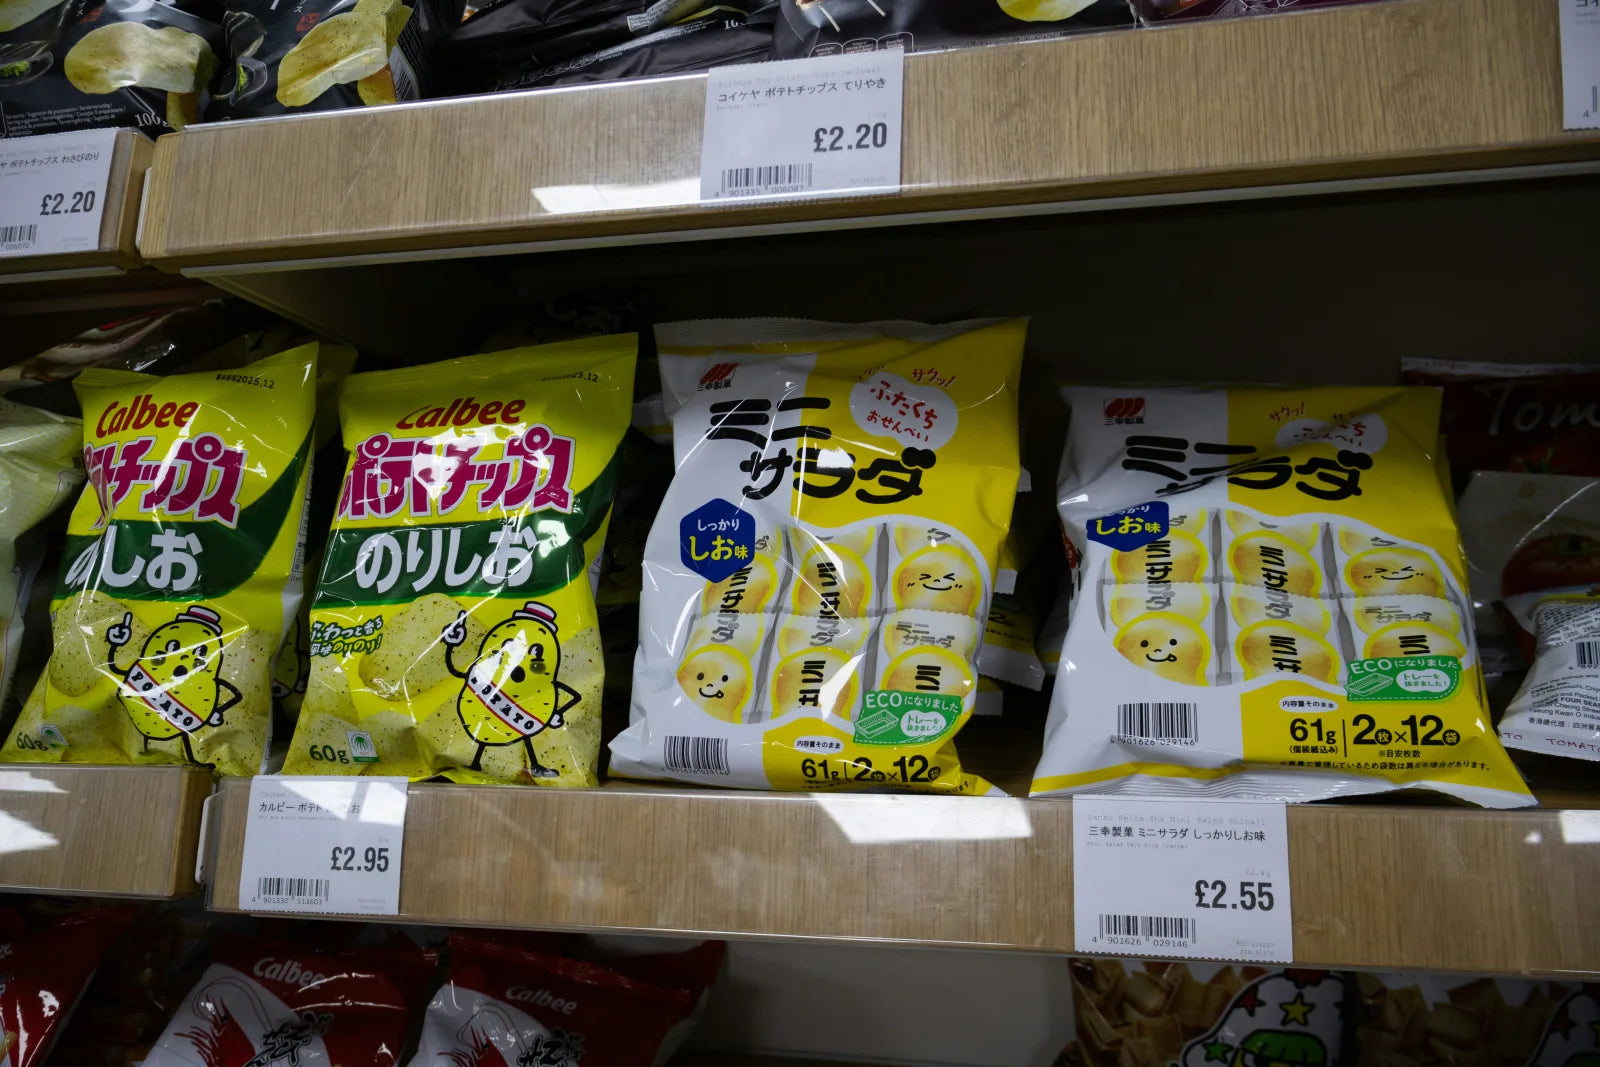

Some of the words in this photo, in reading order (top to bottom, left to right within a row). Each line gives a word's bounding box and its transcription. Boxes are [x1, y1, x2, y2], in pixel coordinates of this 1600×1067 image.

[718, 90, 760, 102] コイケヤ
[765, 82, 837, 97] ポテトチップス
[843, 78, 886, 91] てりやき
[813, 122, 888, 152] £2.20
[9, 155, 58, 168] ポテトチップス
[62, 151, 100, 163] わさびのり
[40, 190, 96, 216] £2.20
[728, 187, 761, 197] 901335
[771, 185, 805, 194] 006087
[96, 394, 200, 439] Calbee
[396, 398, 526, 430] Calbee
[870, 380, 938, 430] ふたくち
[705, 397, 832, 450] ミニ
[867, 409, 930, 442] おせんべい
[1122, 435, 1257, 482] ミニ
[336, 423, 577, 521] ポテトチップス
[739, 446, 937, 504] サラダ
[697, 518, 740, 532] しっかり
[1096, 515, 1162, 535] しお味
[355, 525, 538, 594] のりしお
[689, 534, 749, 562] しお味
[1350, 659, 1461, 675] ECOになりました
[1403, 673, 1441, 681] トレーを
[131, 671, 194, 727] POATO
[865, 692, 960, 713] ECOになりました
[1282, 701, 1335, 709] 内容量そのまま
[908, 714, 940, 724] トレーを
[16, 732, 48, 751] 60g
[1121, 738, 1156, 746] 901626
[1159, 738, 1195, 746] 029146
[1290, 718, 1337, 745] 61g
[310, 744, 350, 764] 60g
[796, 740, 841, 750] 内容量そのまま
[1378, 750, 1421, 759] ※目安枚数
[802, 758, 840, 780] 61g
[1088, 825, 1134, 838] 三幸製菓
[1138, 828, 1188, 841] ミニサラダ
[1193, 829, 1266, 842] しっかりしお味
[330, 846, 390, 873] £2.95
[263, 897, 289, 905] 901330
[297, 897, 323, 906] 513603
[1194, 879, 1275, 911] £2.55
[1107, 936, 1143, 946] 901626
[1152, 938, 1188, 948] 029146
[252, 955, 326, 990] Calbee
[504, 985, 578, 1015] Calbee
